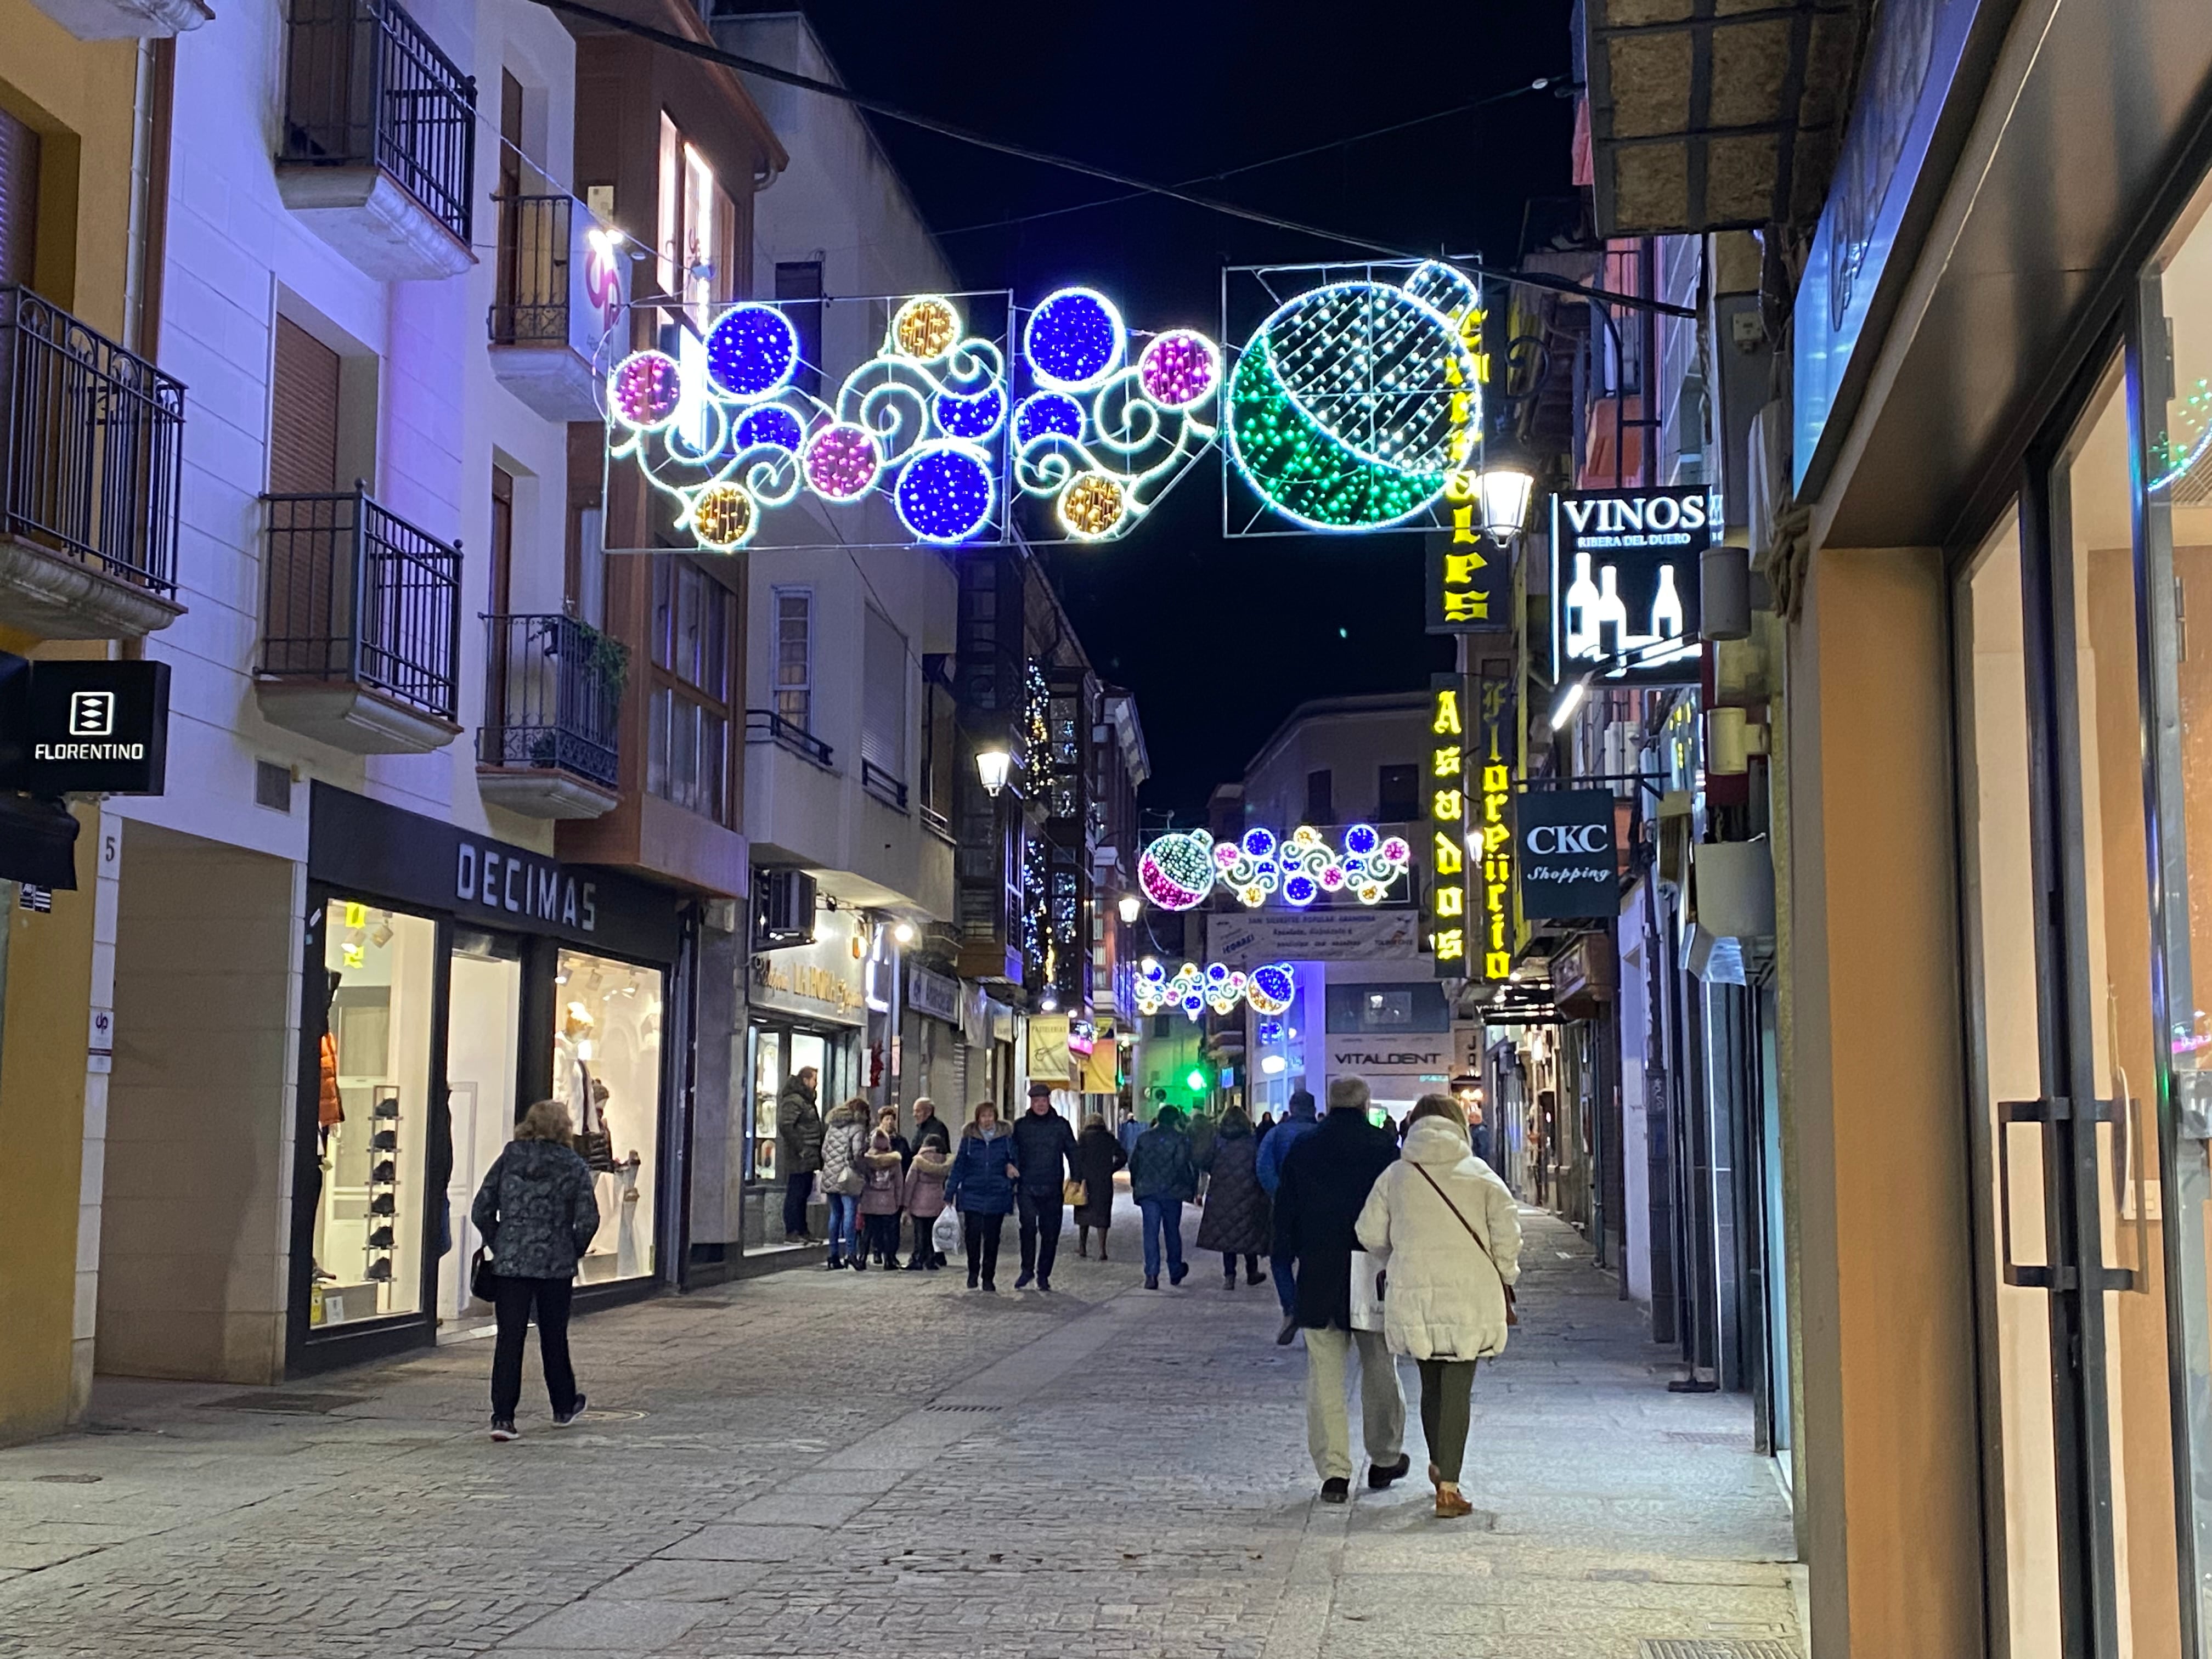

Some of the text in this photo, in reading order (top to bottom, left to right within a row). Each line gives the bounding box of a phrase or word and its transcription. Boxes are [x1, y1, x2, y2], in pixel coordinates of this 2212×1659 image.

[1562, 495, 1706, 533] VINOS
[1578, 533, 1691, 548] RIBERA DEL DUERO
[35, 743, 144, 760] FLORENTINO
[1434, 690, 1463, 960] Asados
[105, 836, 116, 862] 5
[1527, 824, 1608, 855] CKC
[456, 843, 596, 932] DECIMAS
[1527, 866, 1611, 883] Shopping
[1335, 1053, 1441, 1064] VITALDENT
